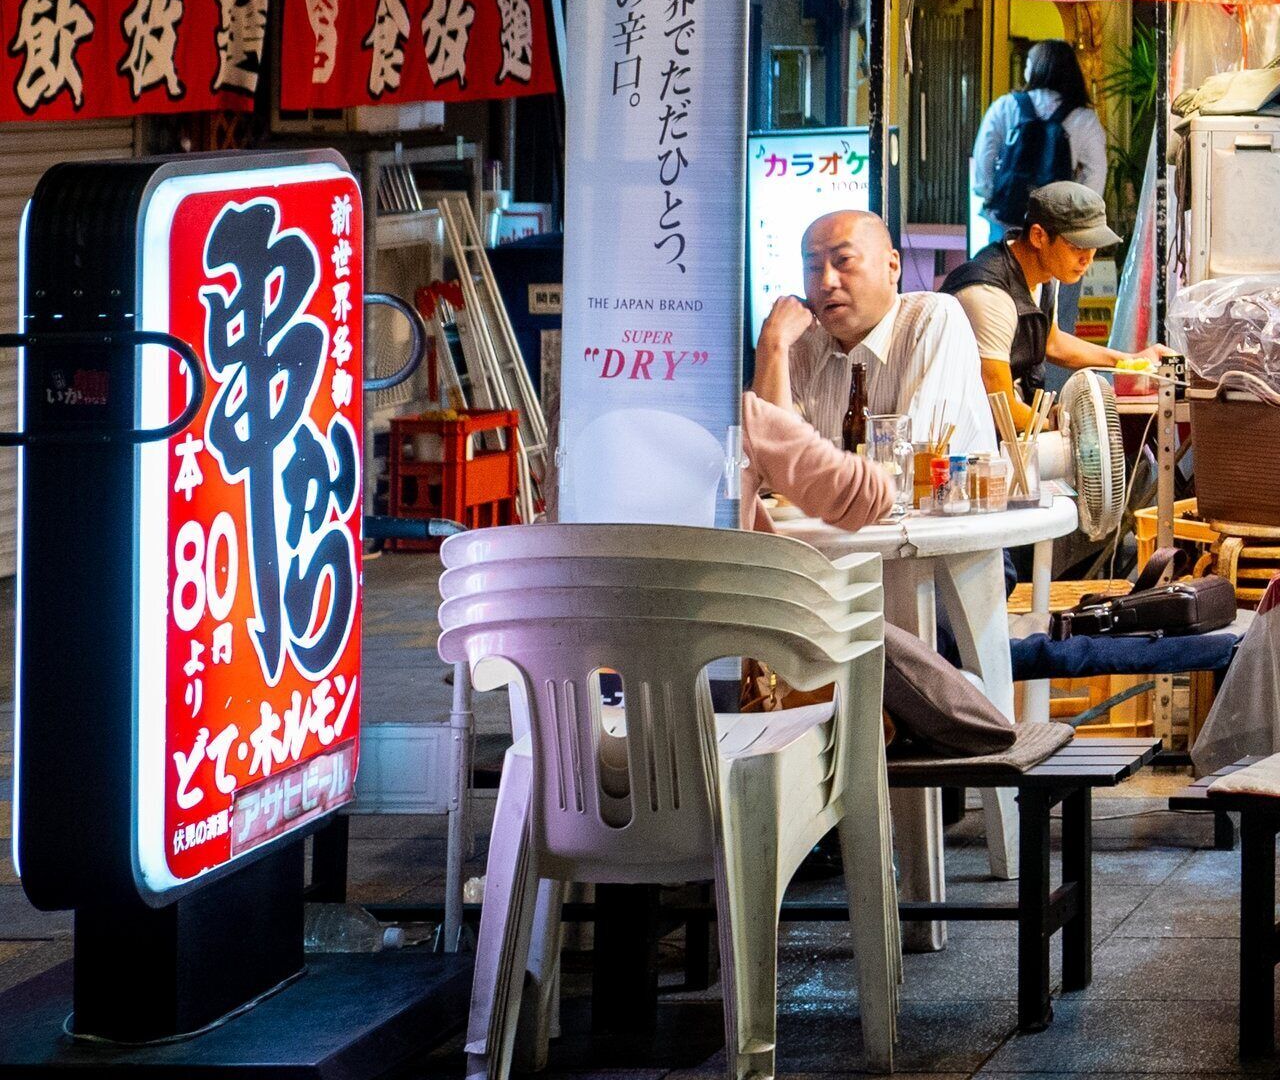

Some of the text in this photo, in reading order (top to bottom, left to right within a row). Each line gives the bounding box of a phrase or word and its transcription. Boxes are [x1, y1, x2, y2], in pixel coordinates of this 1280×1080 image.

[764, 151, 870, 178] カラオケ
[331, 194, 354, 408] 新世界名物
[588, 297, 704, 312] THE JAPAN BRAND
[621, 329, 674, 345] SUPER
[237, 752, 350, 844] アサヒビール
